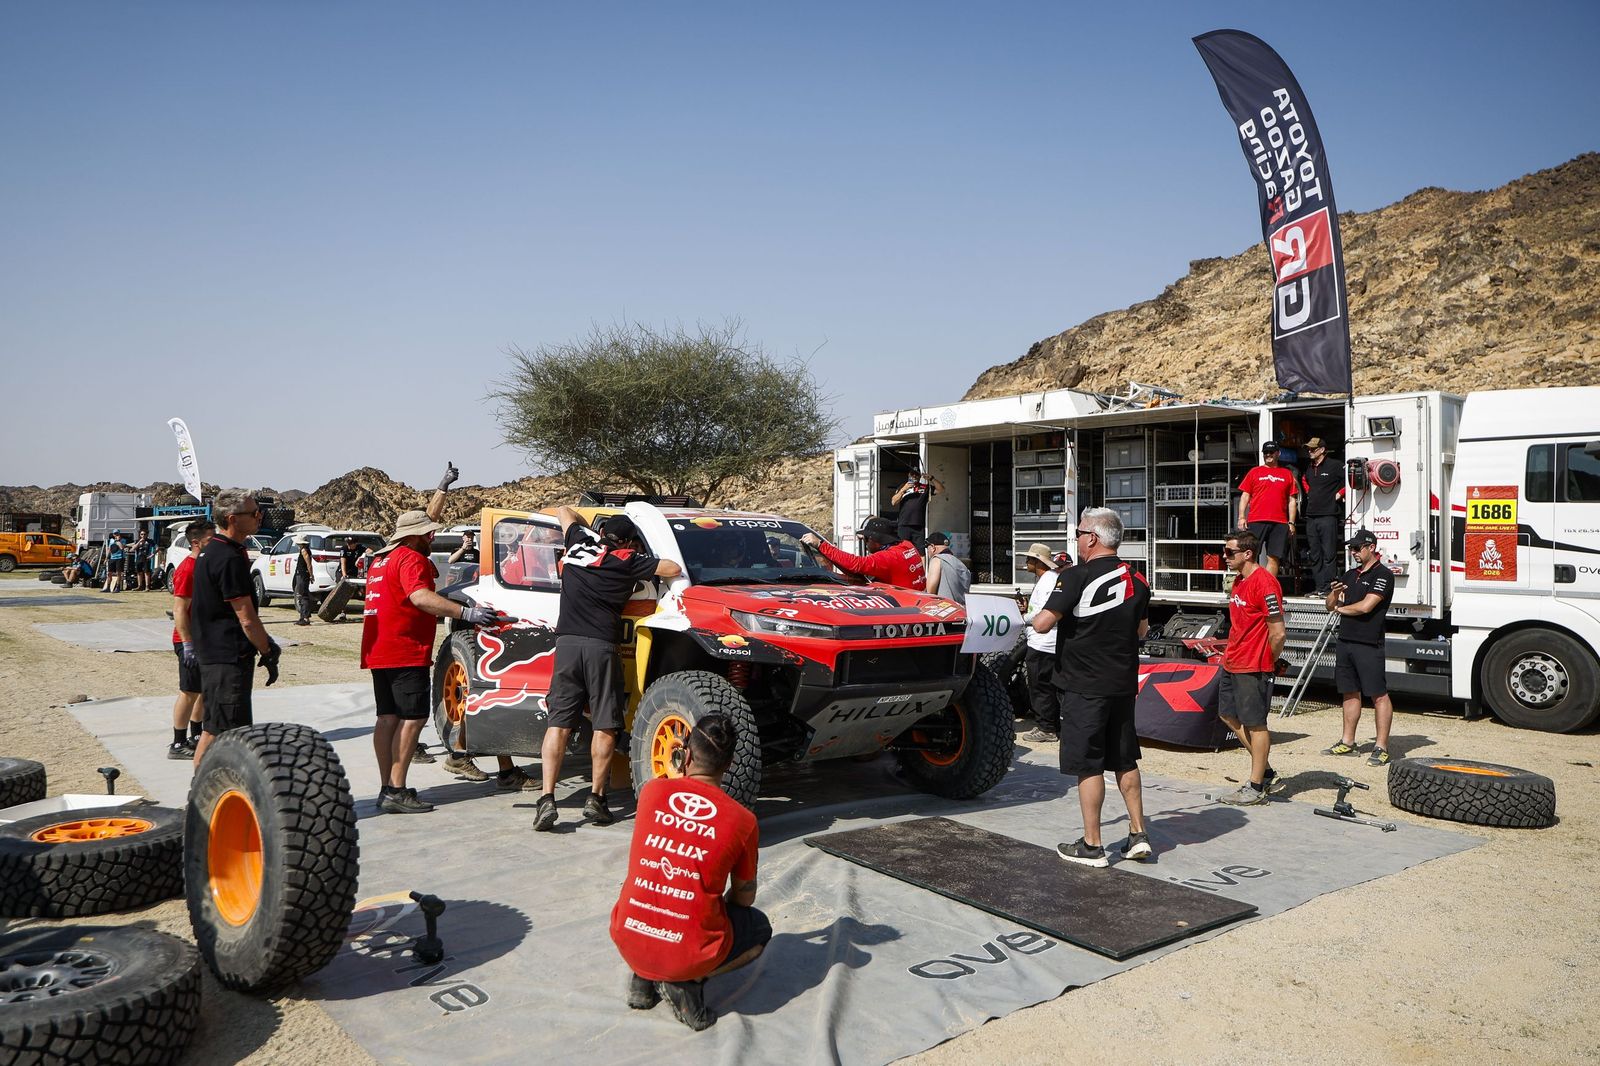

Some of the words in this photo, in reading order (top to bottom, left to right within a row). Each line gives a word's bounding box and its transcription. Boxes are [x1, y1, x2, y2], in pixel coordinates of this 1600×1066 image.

[1471, 504, 1512, 520] 1686
[728, 520, 782, 529] repsol
[1579, 566, 1600, 575] ov
[846, 595, 895, 609] Bull
[758, 608, 799, 618] GR
[873, 622, 946, 638] TOYOTA
[719, 648, 751, 656] repsol
[1416, 647, 1444, 656] MAN
[828, 701, 931, 723] HILUX
[654, 810, 716, 840] TOYOTA
[644, 834, 709, 862] HILUX
[634, 876, 695, 901] HALLSPEED
[624, 917, 684, 942] BFGoodrich
